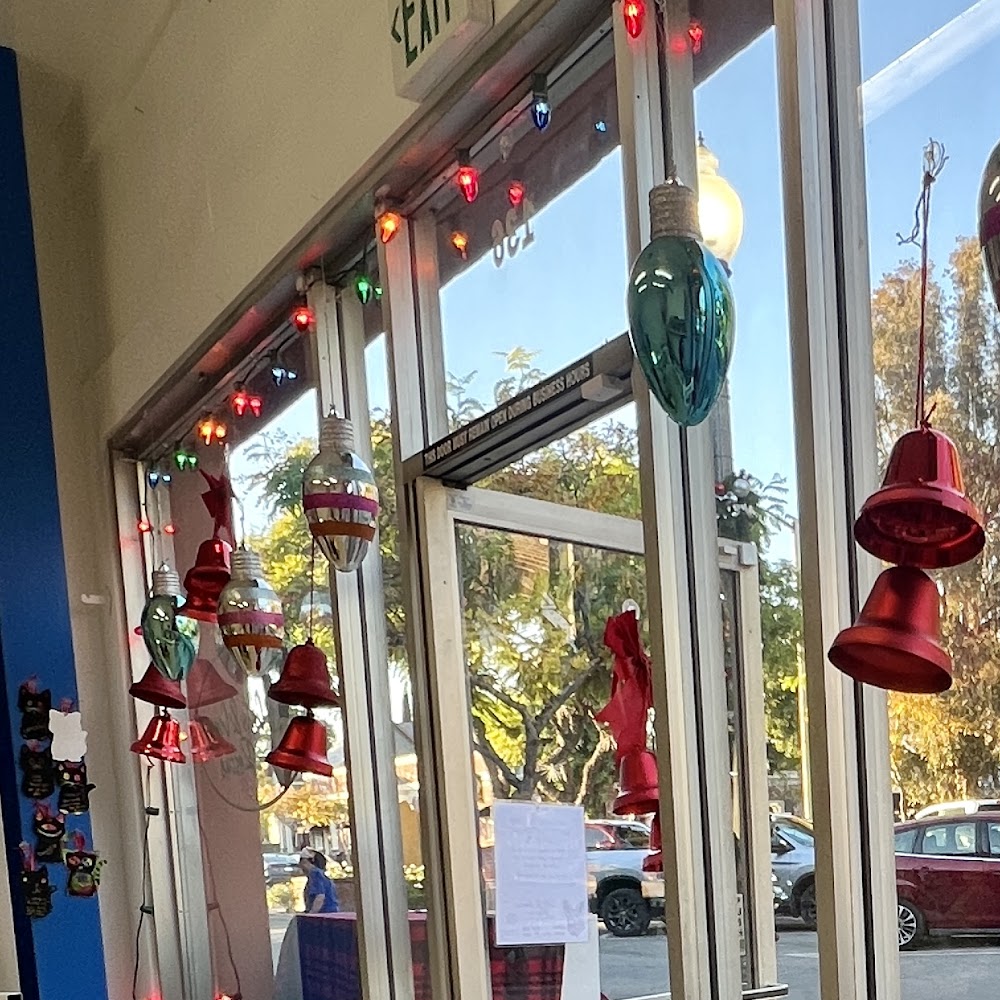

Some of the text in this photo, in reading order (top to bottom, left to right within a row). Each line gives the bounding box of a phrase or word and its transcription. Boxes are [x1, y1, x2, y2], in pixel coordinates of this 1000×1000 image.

[436, 439, 452, 461] DOOR
[452, 430, 467, 451] MUST
[468, 418, 490, 443] REMAIN
[508, 395, 531, 421] DURING
[532, 377, 565, 407] BUSINESS
[565, 362, 591, 389] HOURS
